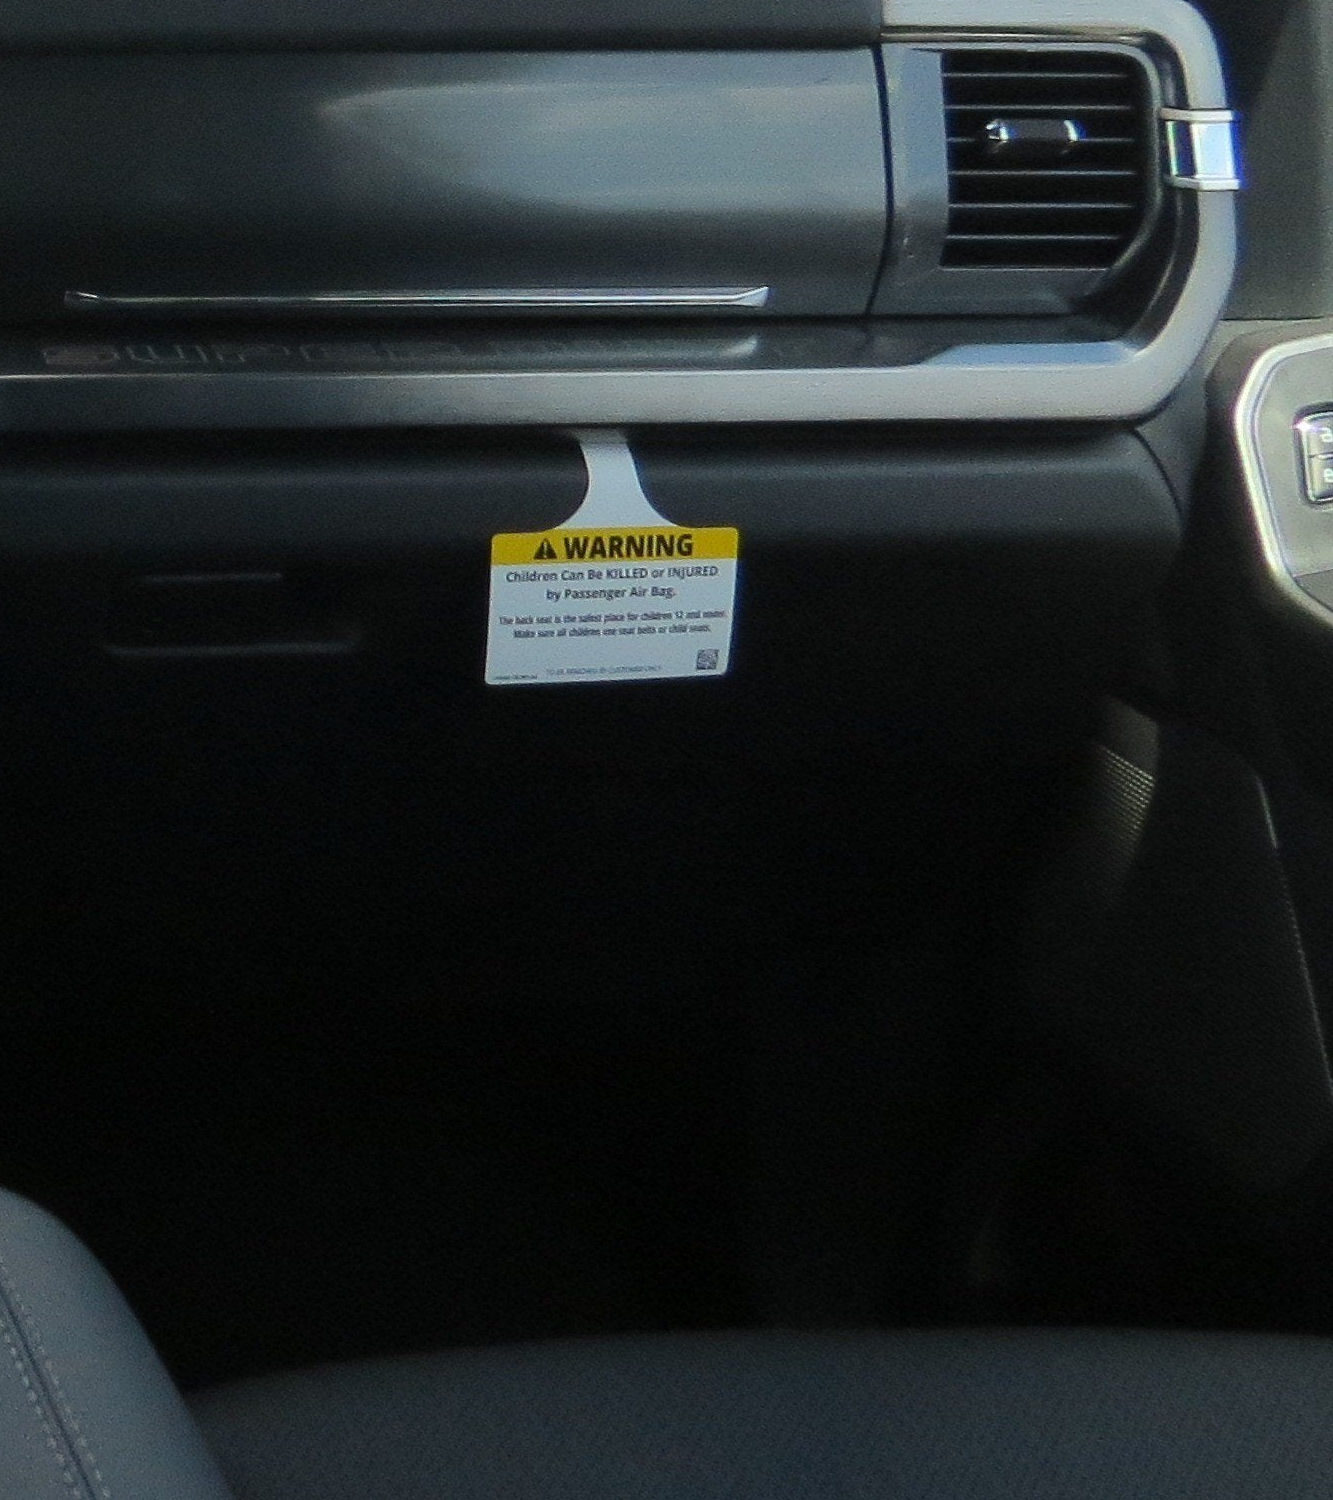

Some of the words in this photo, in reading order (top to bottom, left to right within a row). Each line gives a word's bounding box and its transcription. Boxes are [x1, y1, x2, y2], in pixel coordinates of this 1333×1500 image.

[564, 533, 694, 560] WARNING
[506, 570, 558, 583] Children
[561, 569, 584, 581] Can
[587, 569, 603, 580] Be
[606, 567, 648, 579] KILLED
[651, 568, 665, 578] or
[667, 566, 719, 579] INJURED
[546, 589, 561, 603] by
[564, 588, 627, 601] Passenger
[630, 586, 648, 597] Air
[651, 586, 676, 599] Bag.
[563, 614, 577, 623] the
